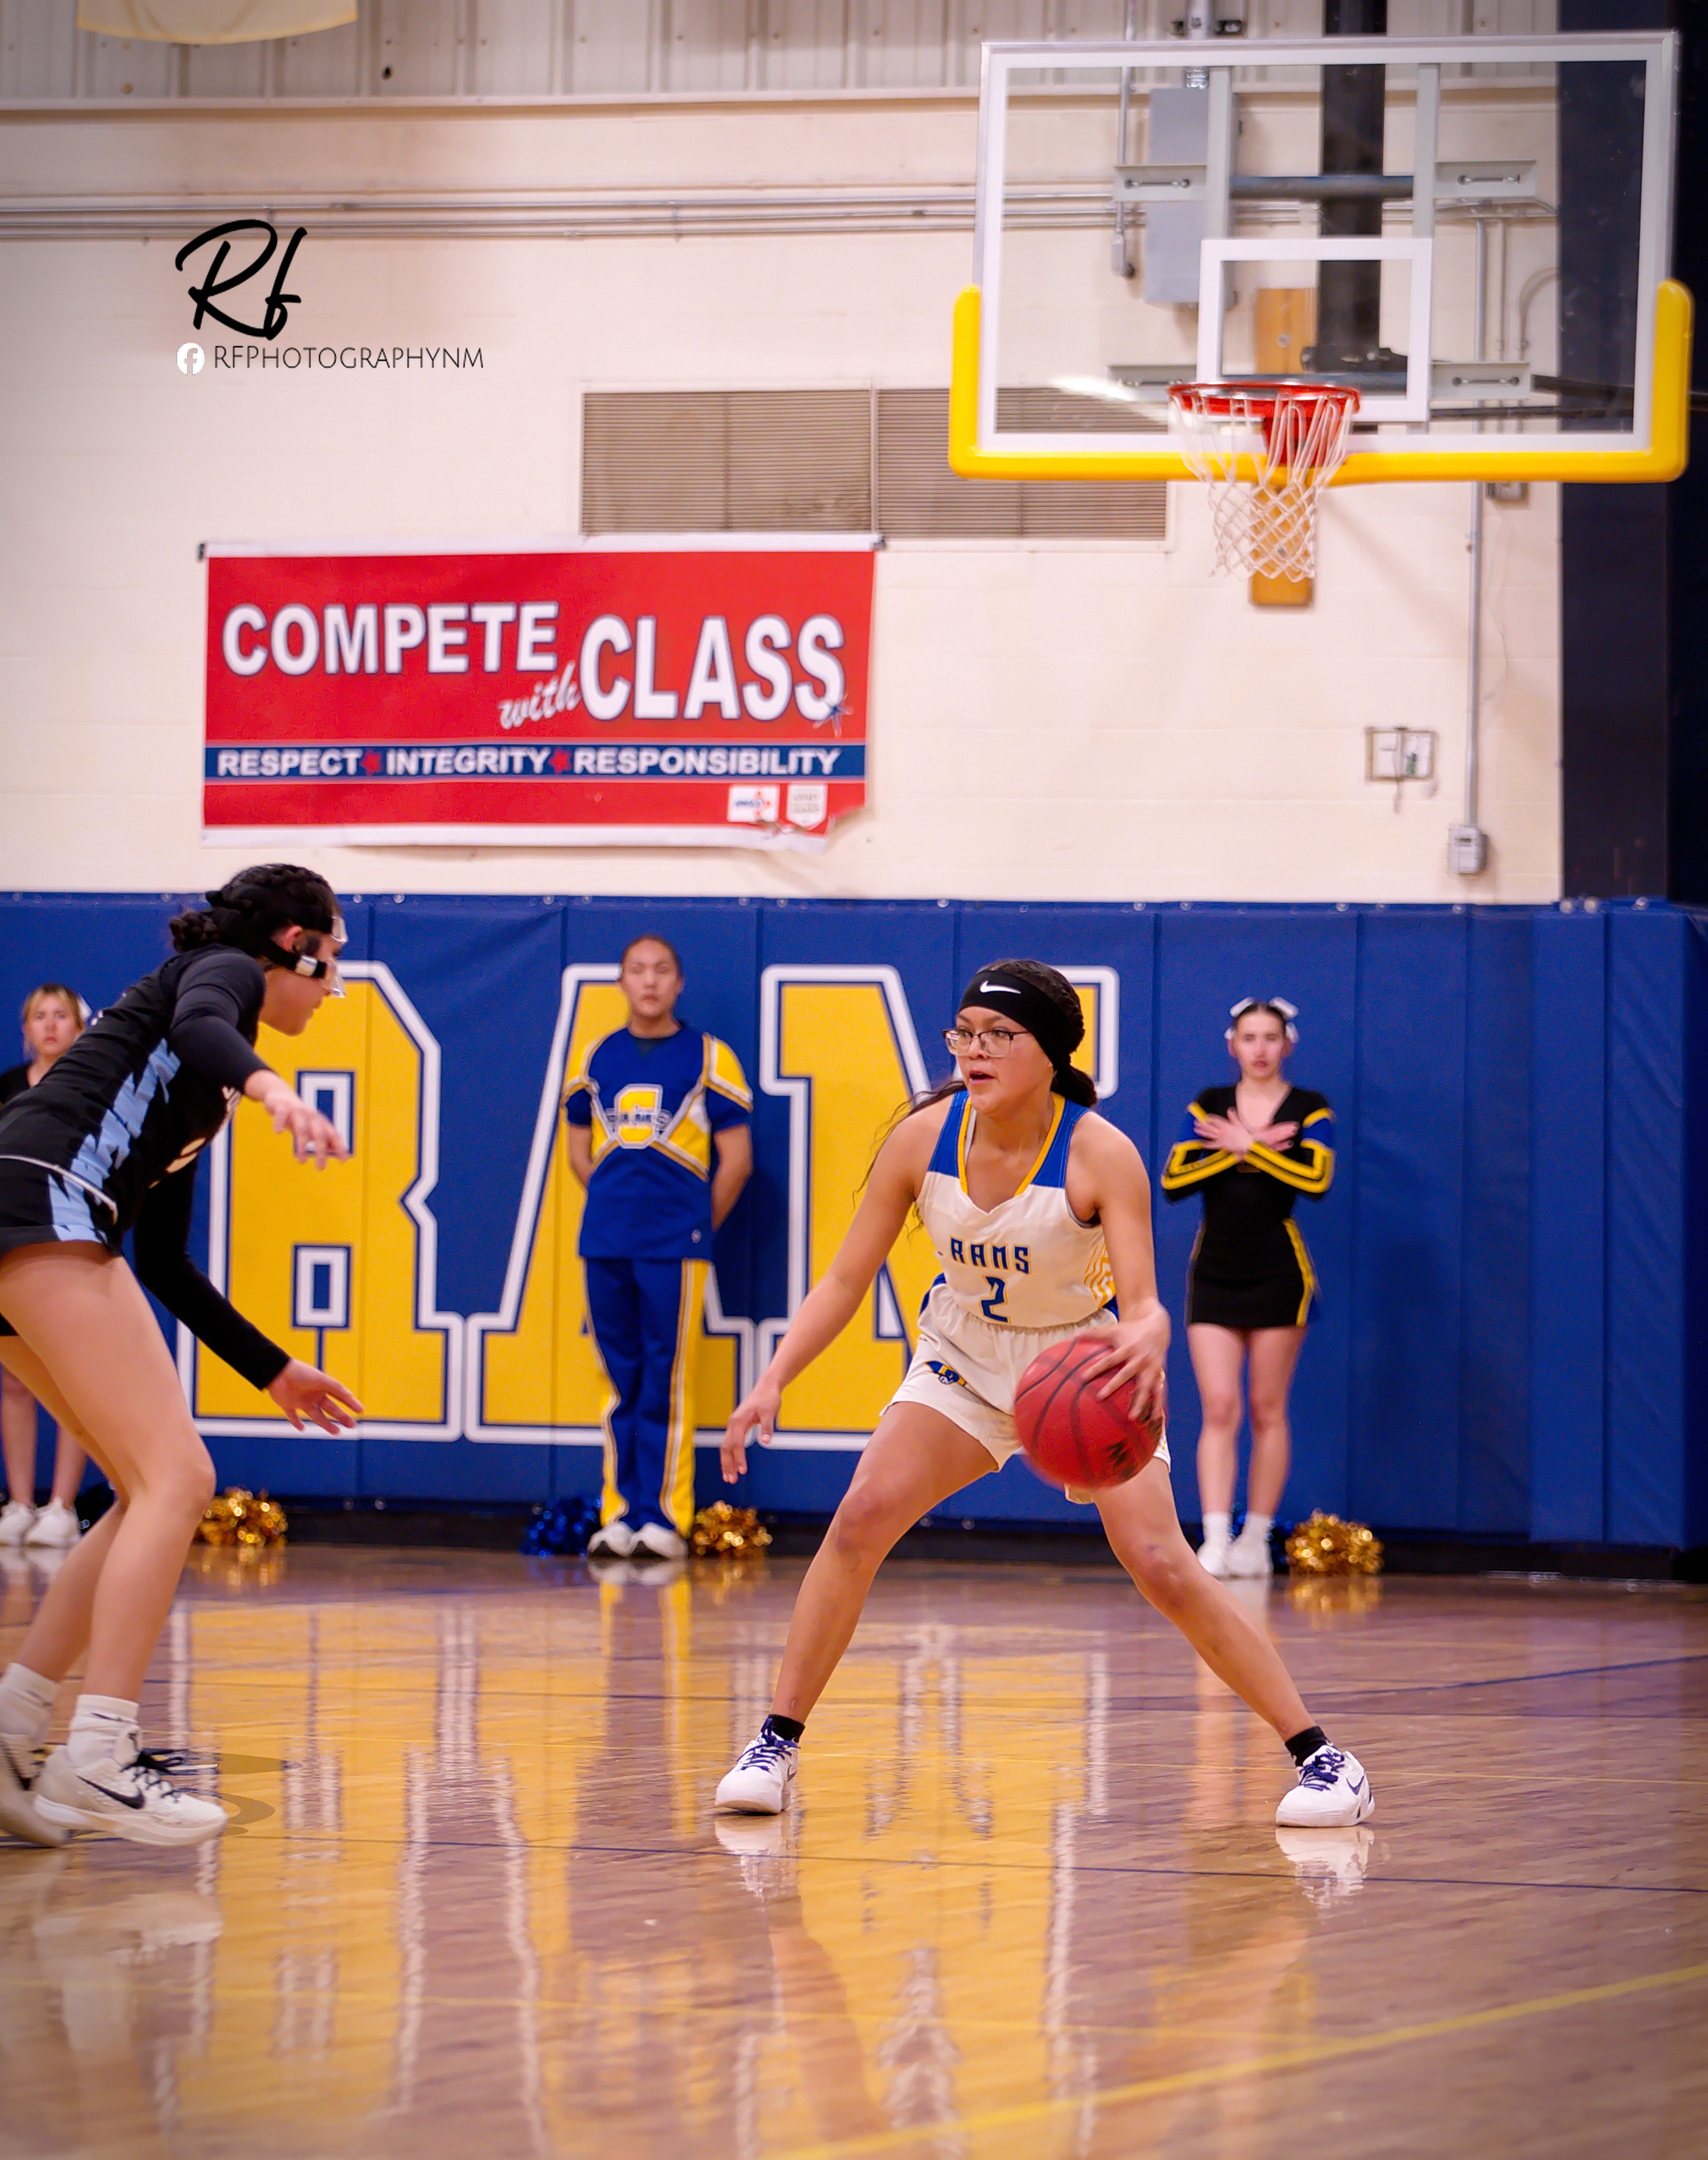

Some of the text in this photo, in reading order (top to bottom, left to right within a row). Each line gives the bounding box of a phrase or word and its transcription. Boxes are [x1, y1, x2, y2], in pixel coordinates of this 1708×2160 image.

[222, 601, 559, 676] COMPETE
[580, 613, 845, 721] CLASS
[497, 660, 581, 729] with
[217, 747, 841, 777] RESPECT INTEGRITY RESPONSIBILITY
[950, 1237, 1030, 1275] RAMS
[980, 1275, 1010, 1323] 2
